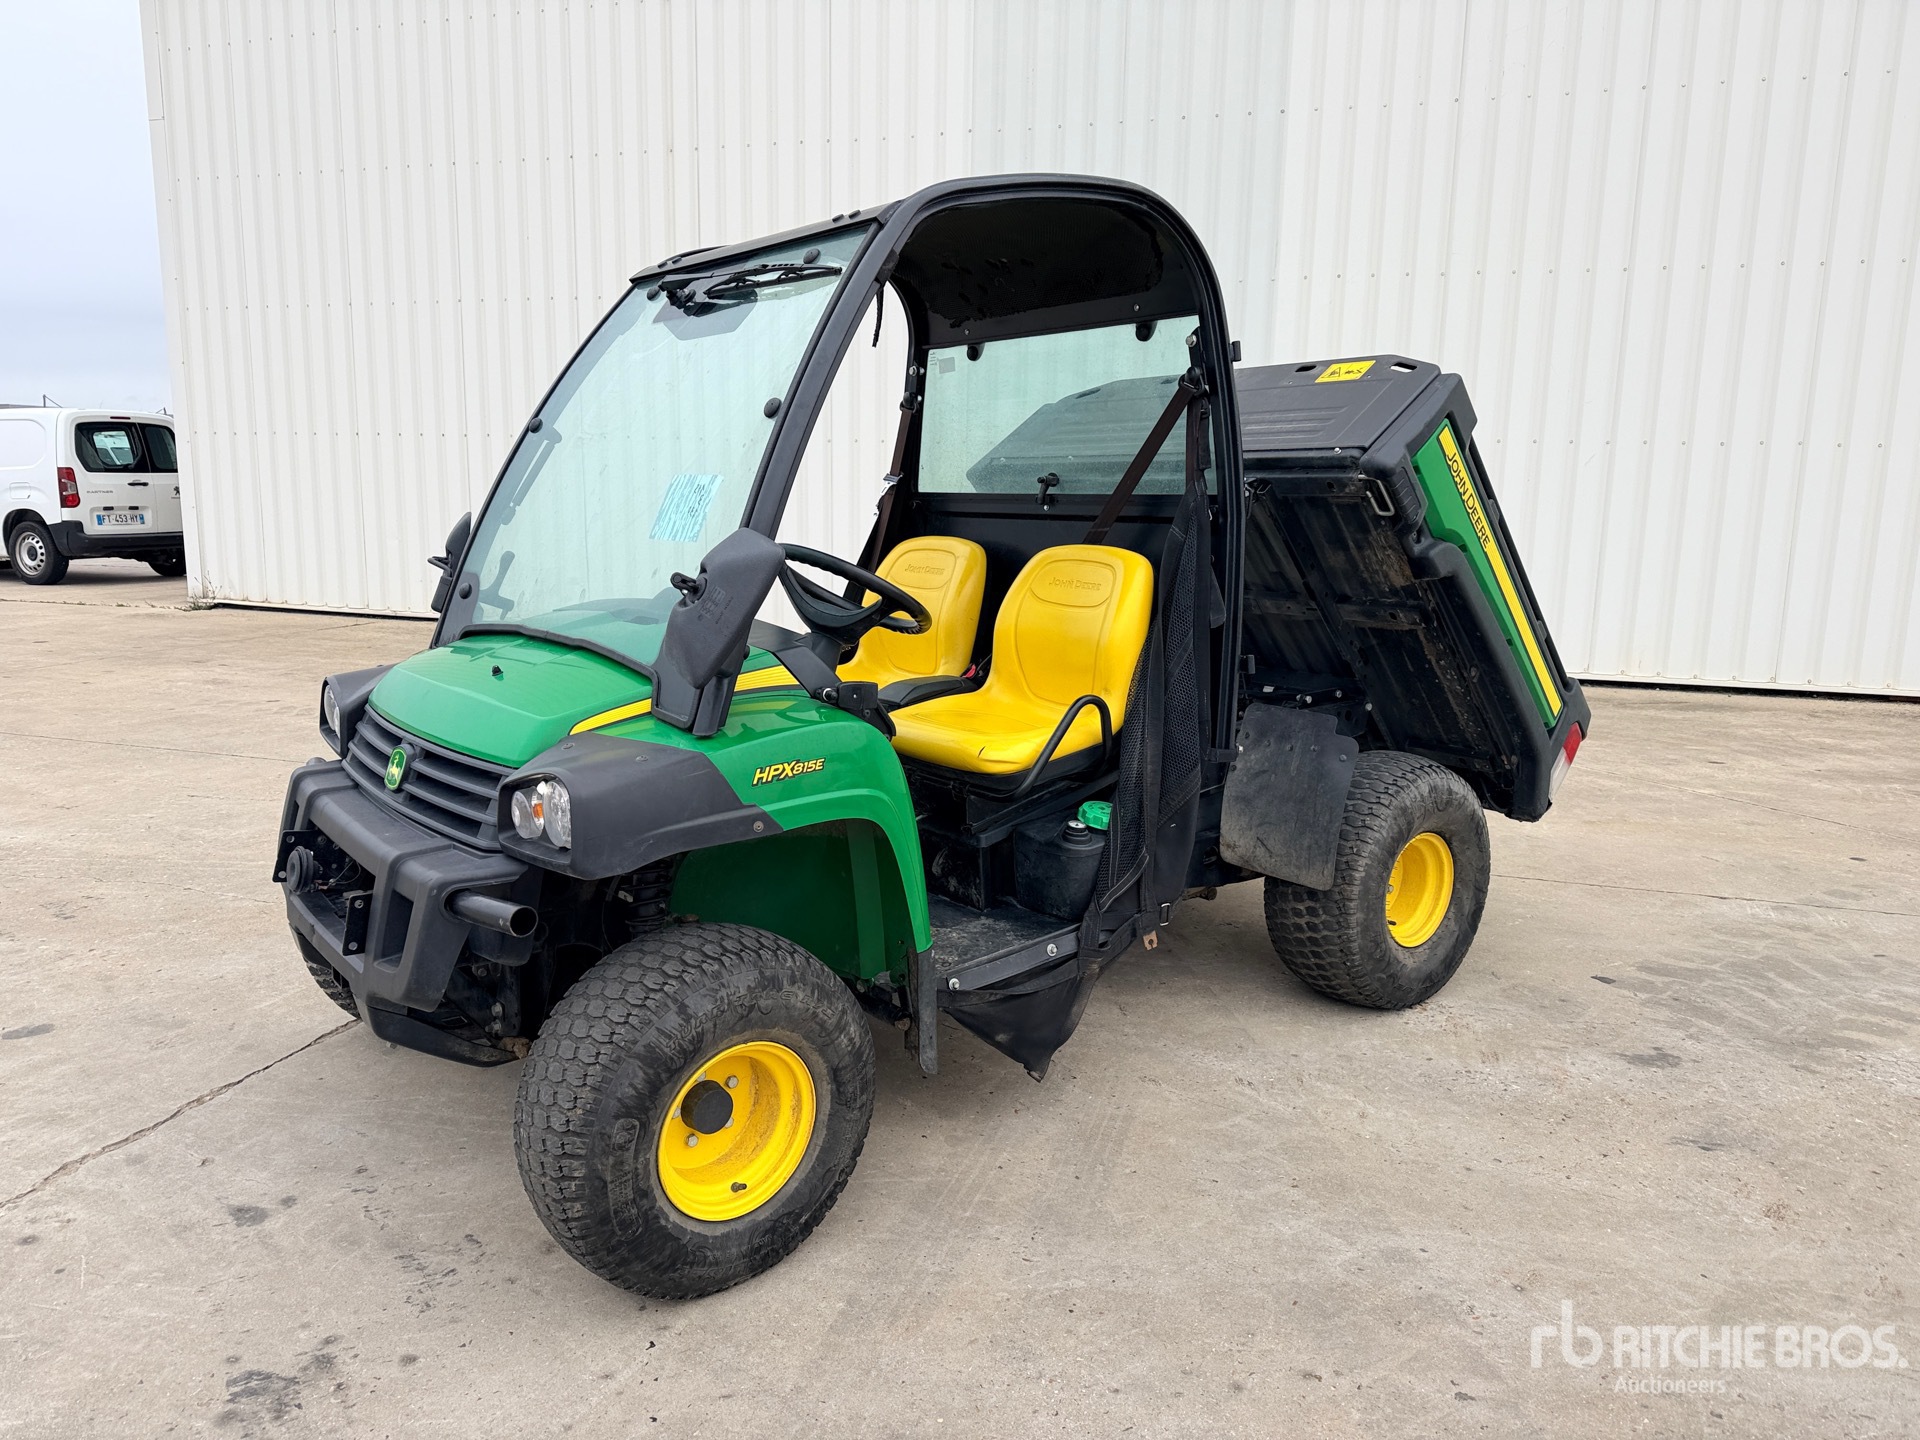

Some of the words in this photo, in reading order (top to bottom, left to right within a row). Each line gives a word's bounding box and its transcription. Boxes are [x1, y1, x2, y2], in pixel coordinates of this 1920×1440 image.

[1446, 453, 1468, 497] JOHN
[1465, 493, 1491, 548] DEERE
[1049, 577, 1075, 589] JOHN
[1074, 579, 1102, 591] DEERE
